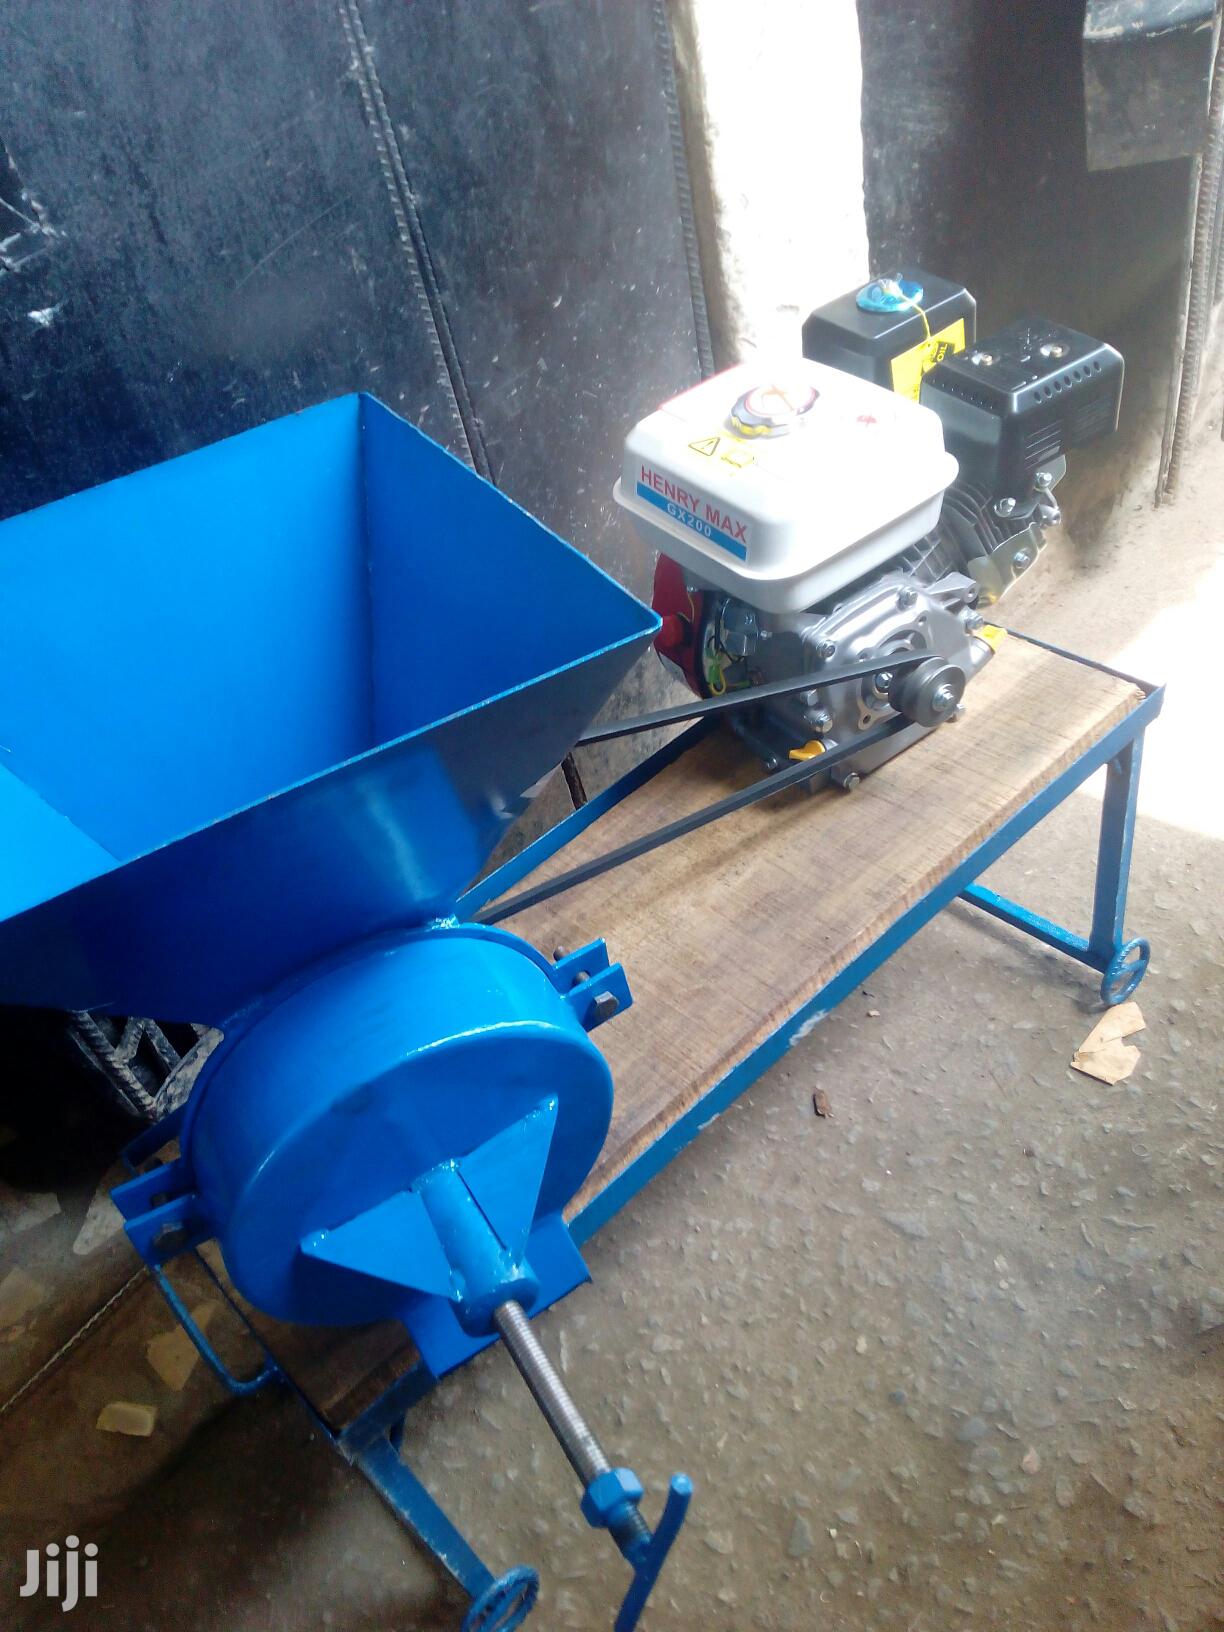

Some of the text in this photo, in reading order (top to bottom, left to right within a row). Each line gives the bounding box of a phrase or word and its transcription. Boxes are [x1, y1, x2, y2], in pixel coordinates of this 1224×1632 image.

[641, 464, 747, 544] HENRY MAX
[667, 502, 712, 537] GX200
